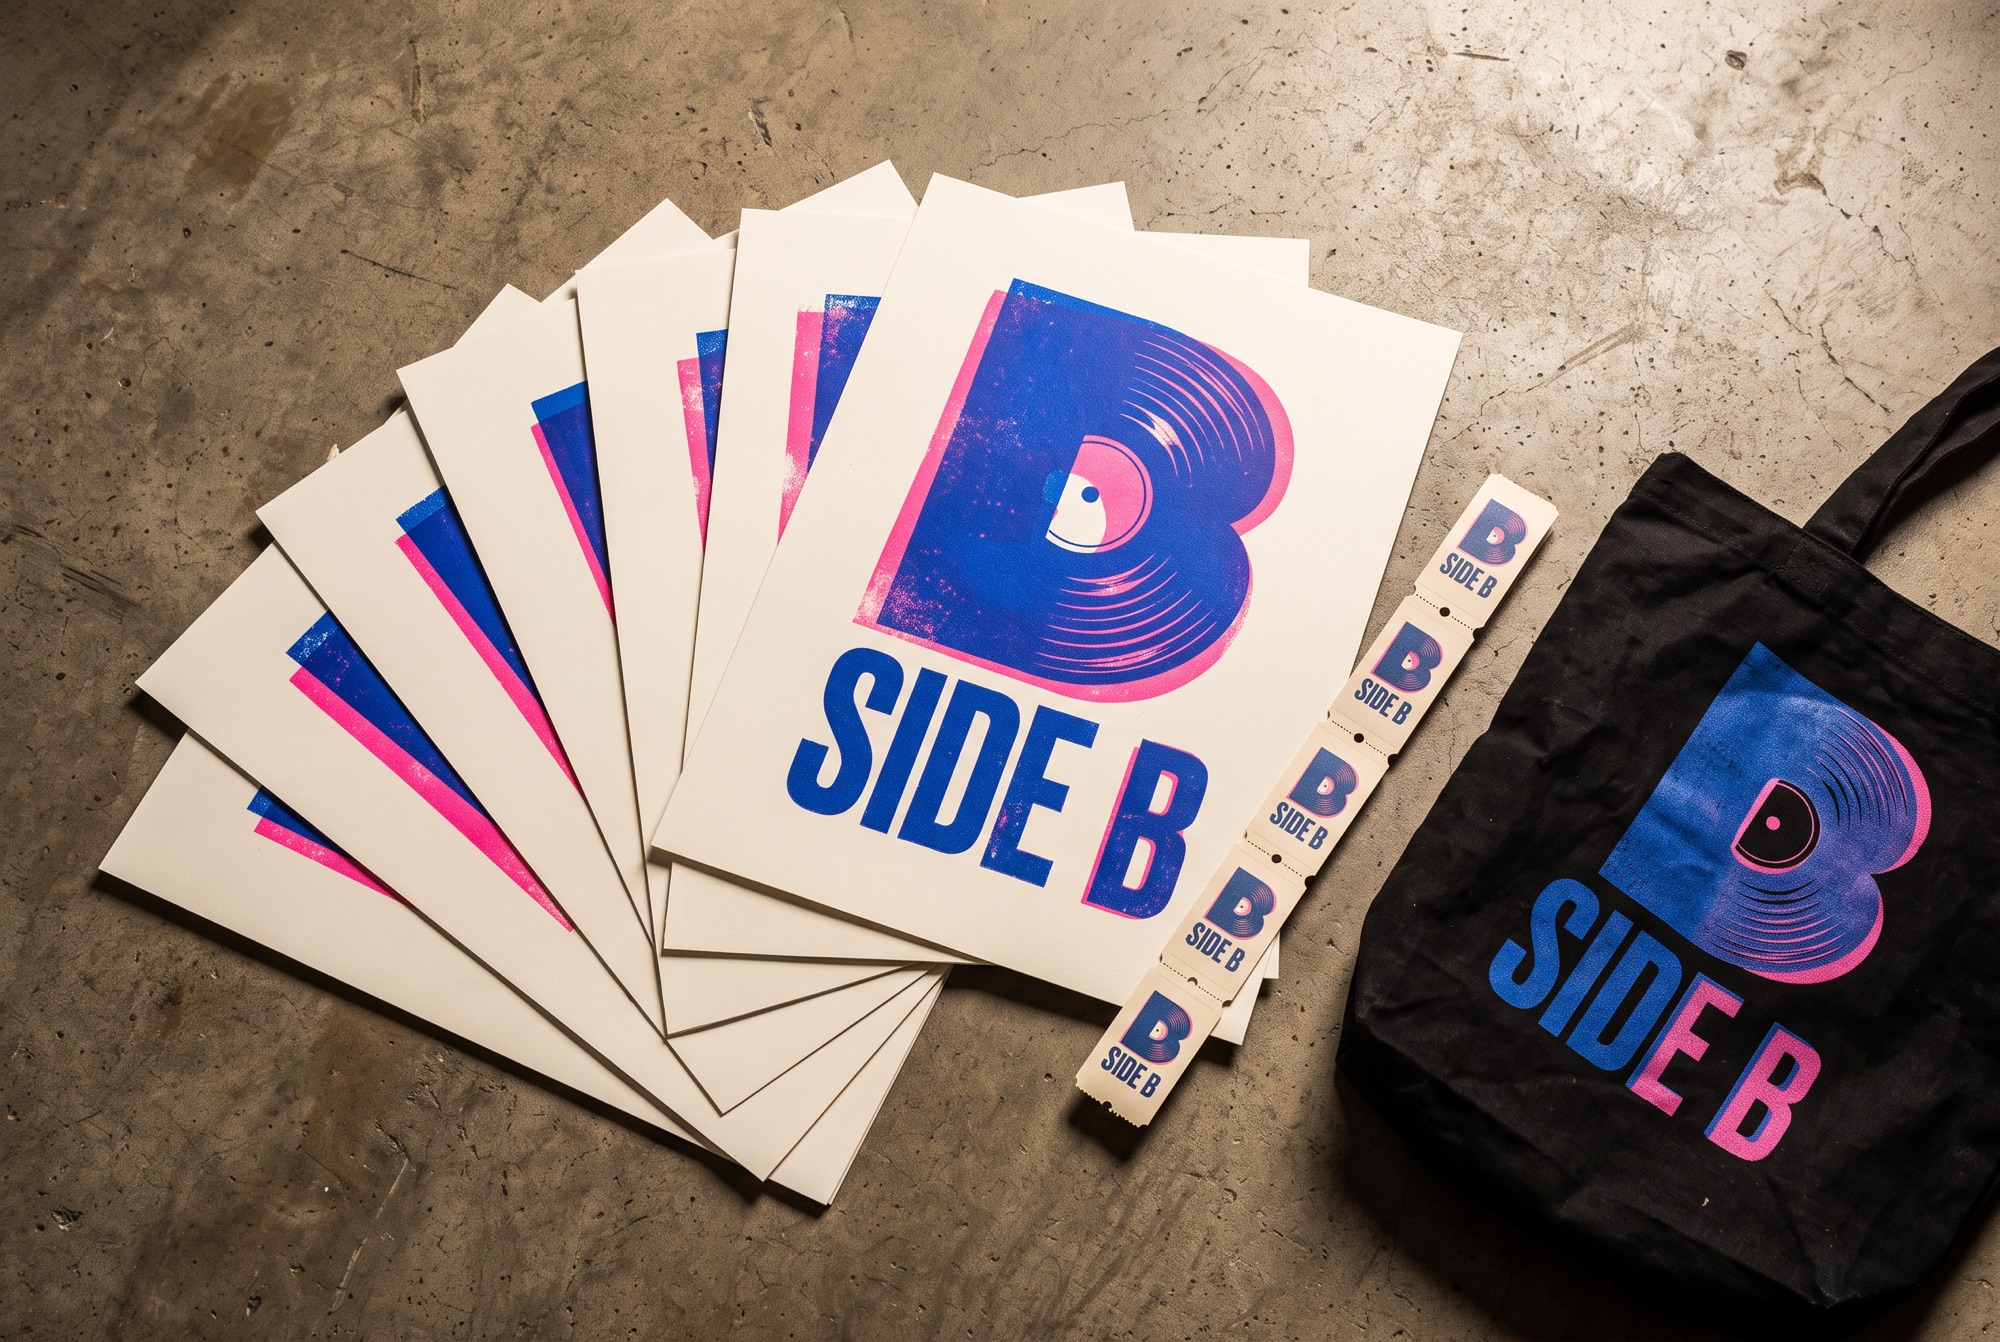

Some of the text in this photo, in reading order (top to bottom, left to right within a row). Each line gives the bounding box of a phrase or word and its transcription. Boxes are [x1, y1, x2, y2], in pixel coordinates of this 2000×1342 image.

[852, 277, 1295, 703] B
[1456, 498, 1527, 566] B
[1440, 552, 1497, 598] SIDE B
[1371, 621, 1442, 692] B
[1354, 678, 1411, 725] SIDE B
[786, 647, 1100, 888] SIDE
[1081, 738, 1209, 920] B
[1287, 746, 1358, 818] B
[1598, 640, 1932, 985] B
[1270, 801, 1328, 850] SIDE B
[1203, 866, 1276, 939] B
[1186, 922, 1245, 971] SIDE B
[1119, 990, 1192, 1064] B
[1488, 878, 1822, 1162] SIDE B
[1101, 1046, 1160, 1097] SIDE B
